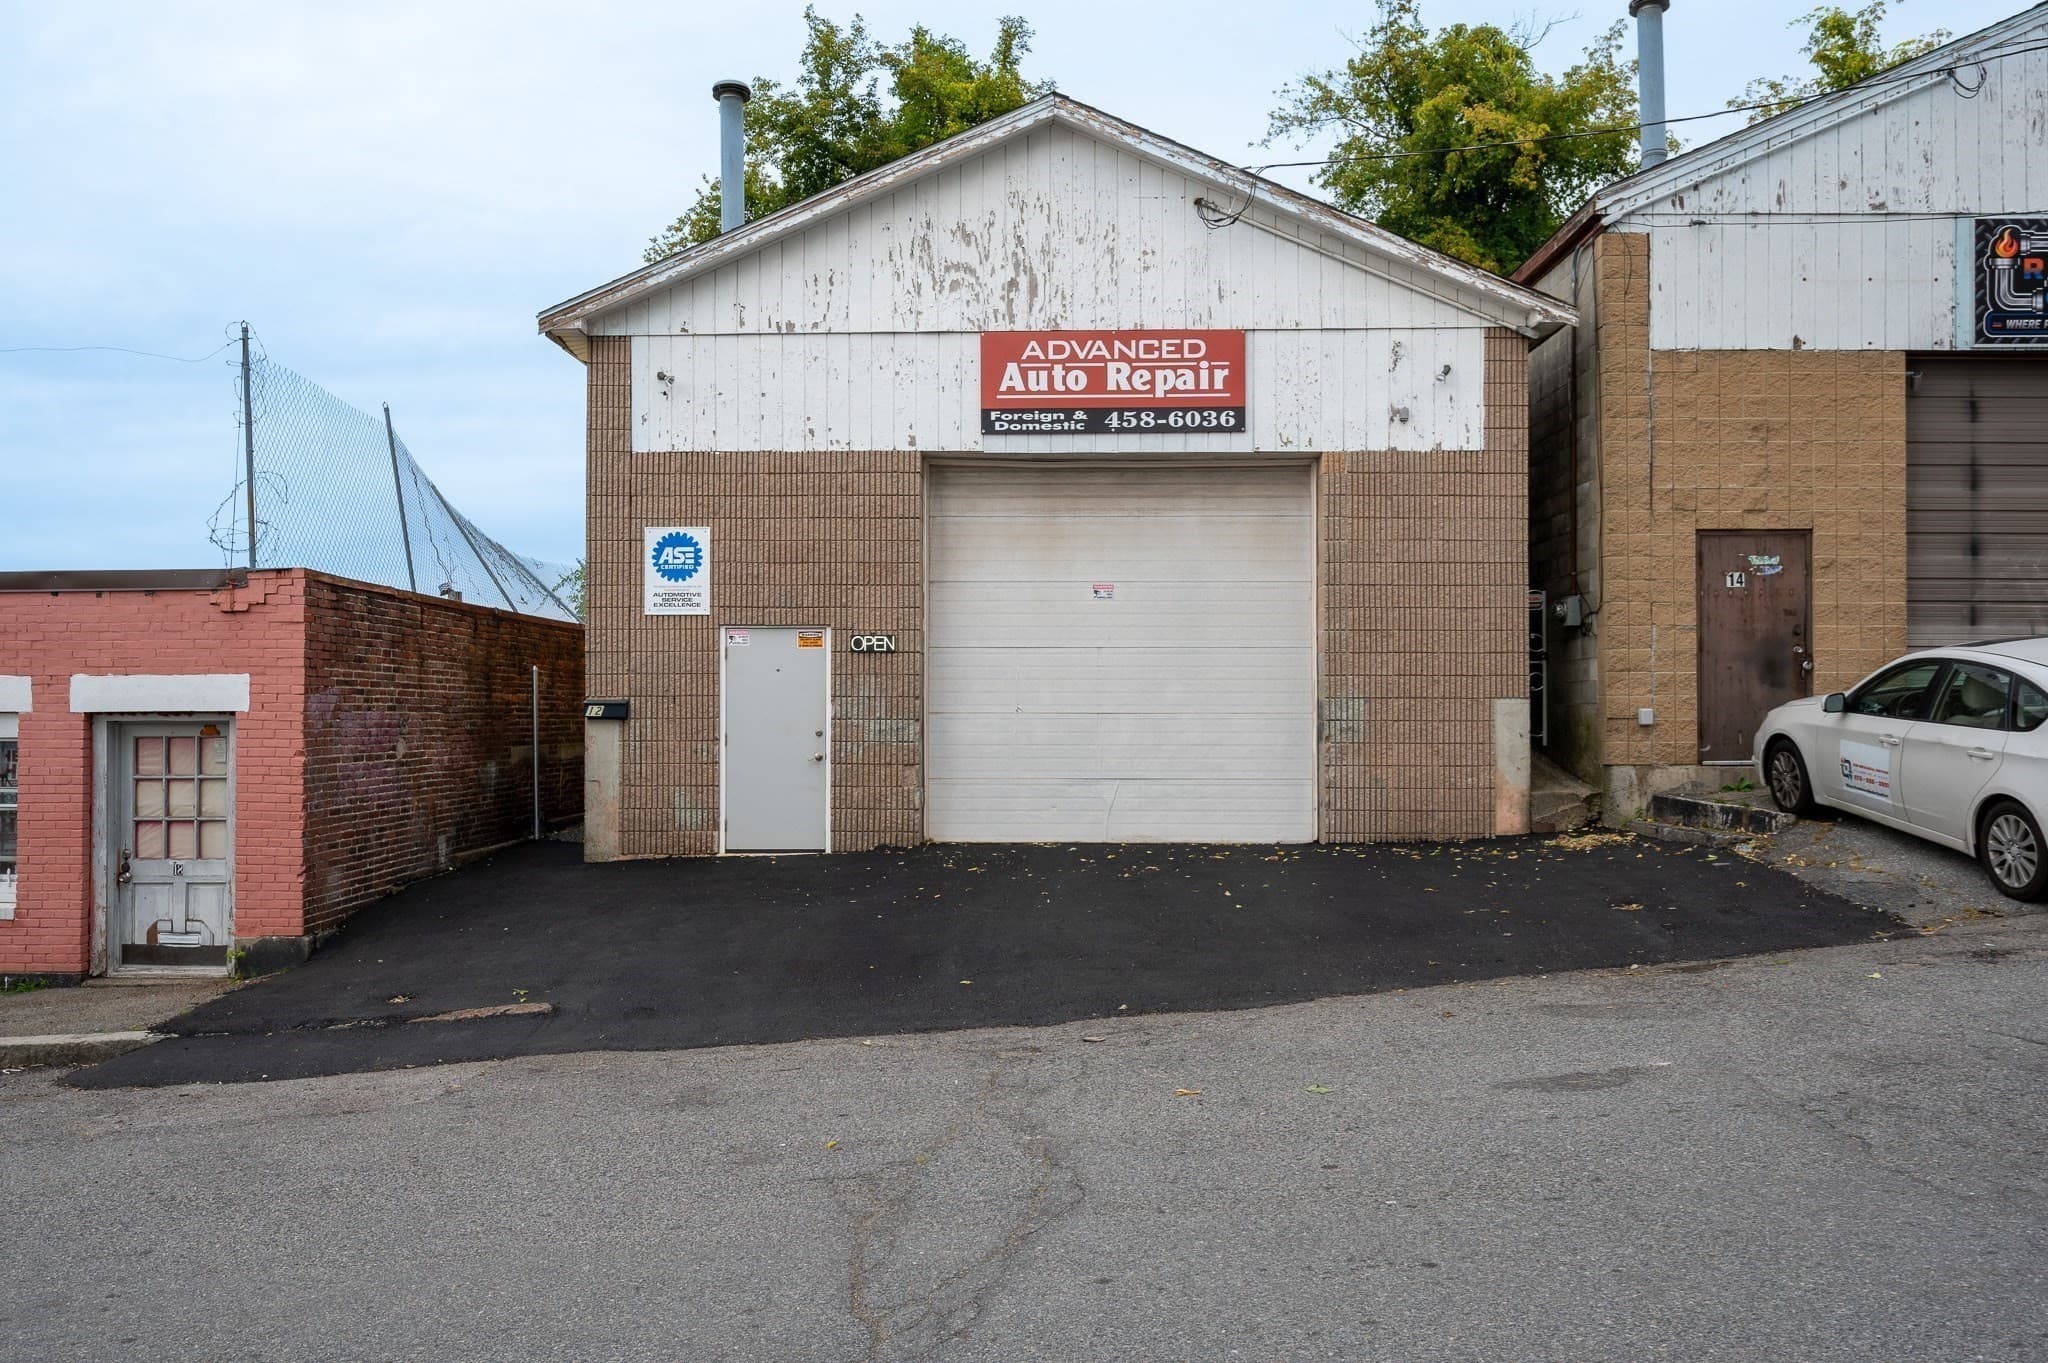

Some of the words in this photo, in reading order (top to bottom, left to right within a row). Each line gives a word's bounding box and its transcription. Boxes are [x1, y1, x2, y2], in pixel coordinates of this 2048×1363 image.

[2006, 319, 2042, 329] WHERE
[1021, 339, 1207, 360] ADVANCED
[999, 363, 1088, 391] Auto
[1106, 361, 1229, 398] Repair
[990, 411, 1065, 422] Foreign
[1073, 411, 1088, 420] &
[1104, 410, 1236, 428] 458-6036
[994, 421, 1085, 431] Domestic
[658, 547, 695, 564] ASE
[1729, 573, 1744, 586] 14
[851, 635, 895, 651] OPEN
[588, 706, 602, 716] 12
